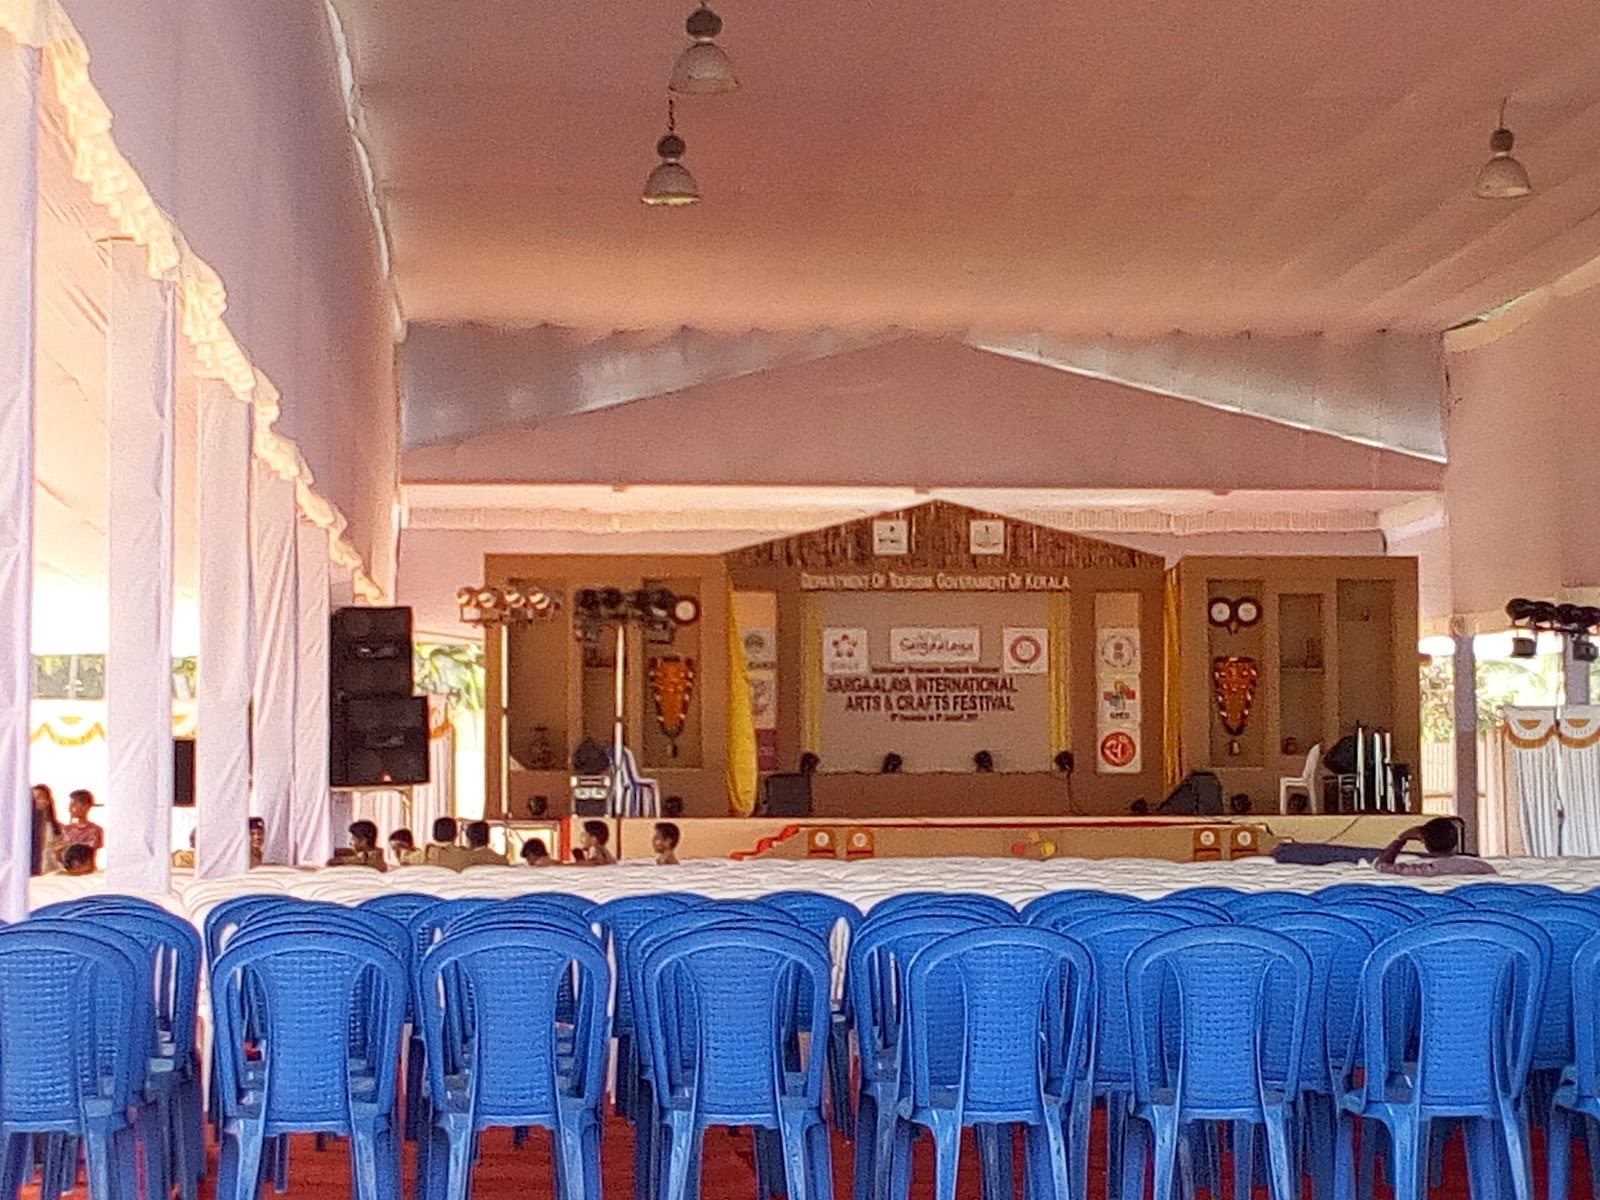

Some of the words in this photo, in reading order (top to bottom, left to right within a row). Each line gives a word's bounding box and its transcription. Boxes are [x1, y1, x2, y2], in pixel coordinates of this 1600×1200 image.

[915, 676, 1019, 694] INTERNATIONAL
[845, 694, 881, 712] ARTS
[896, 694, 950, 711] CRAFTS
[952, 694, 1015, 712] FESTIVAL
